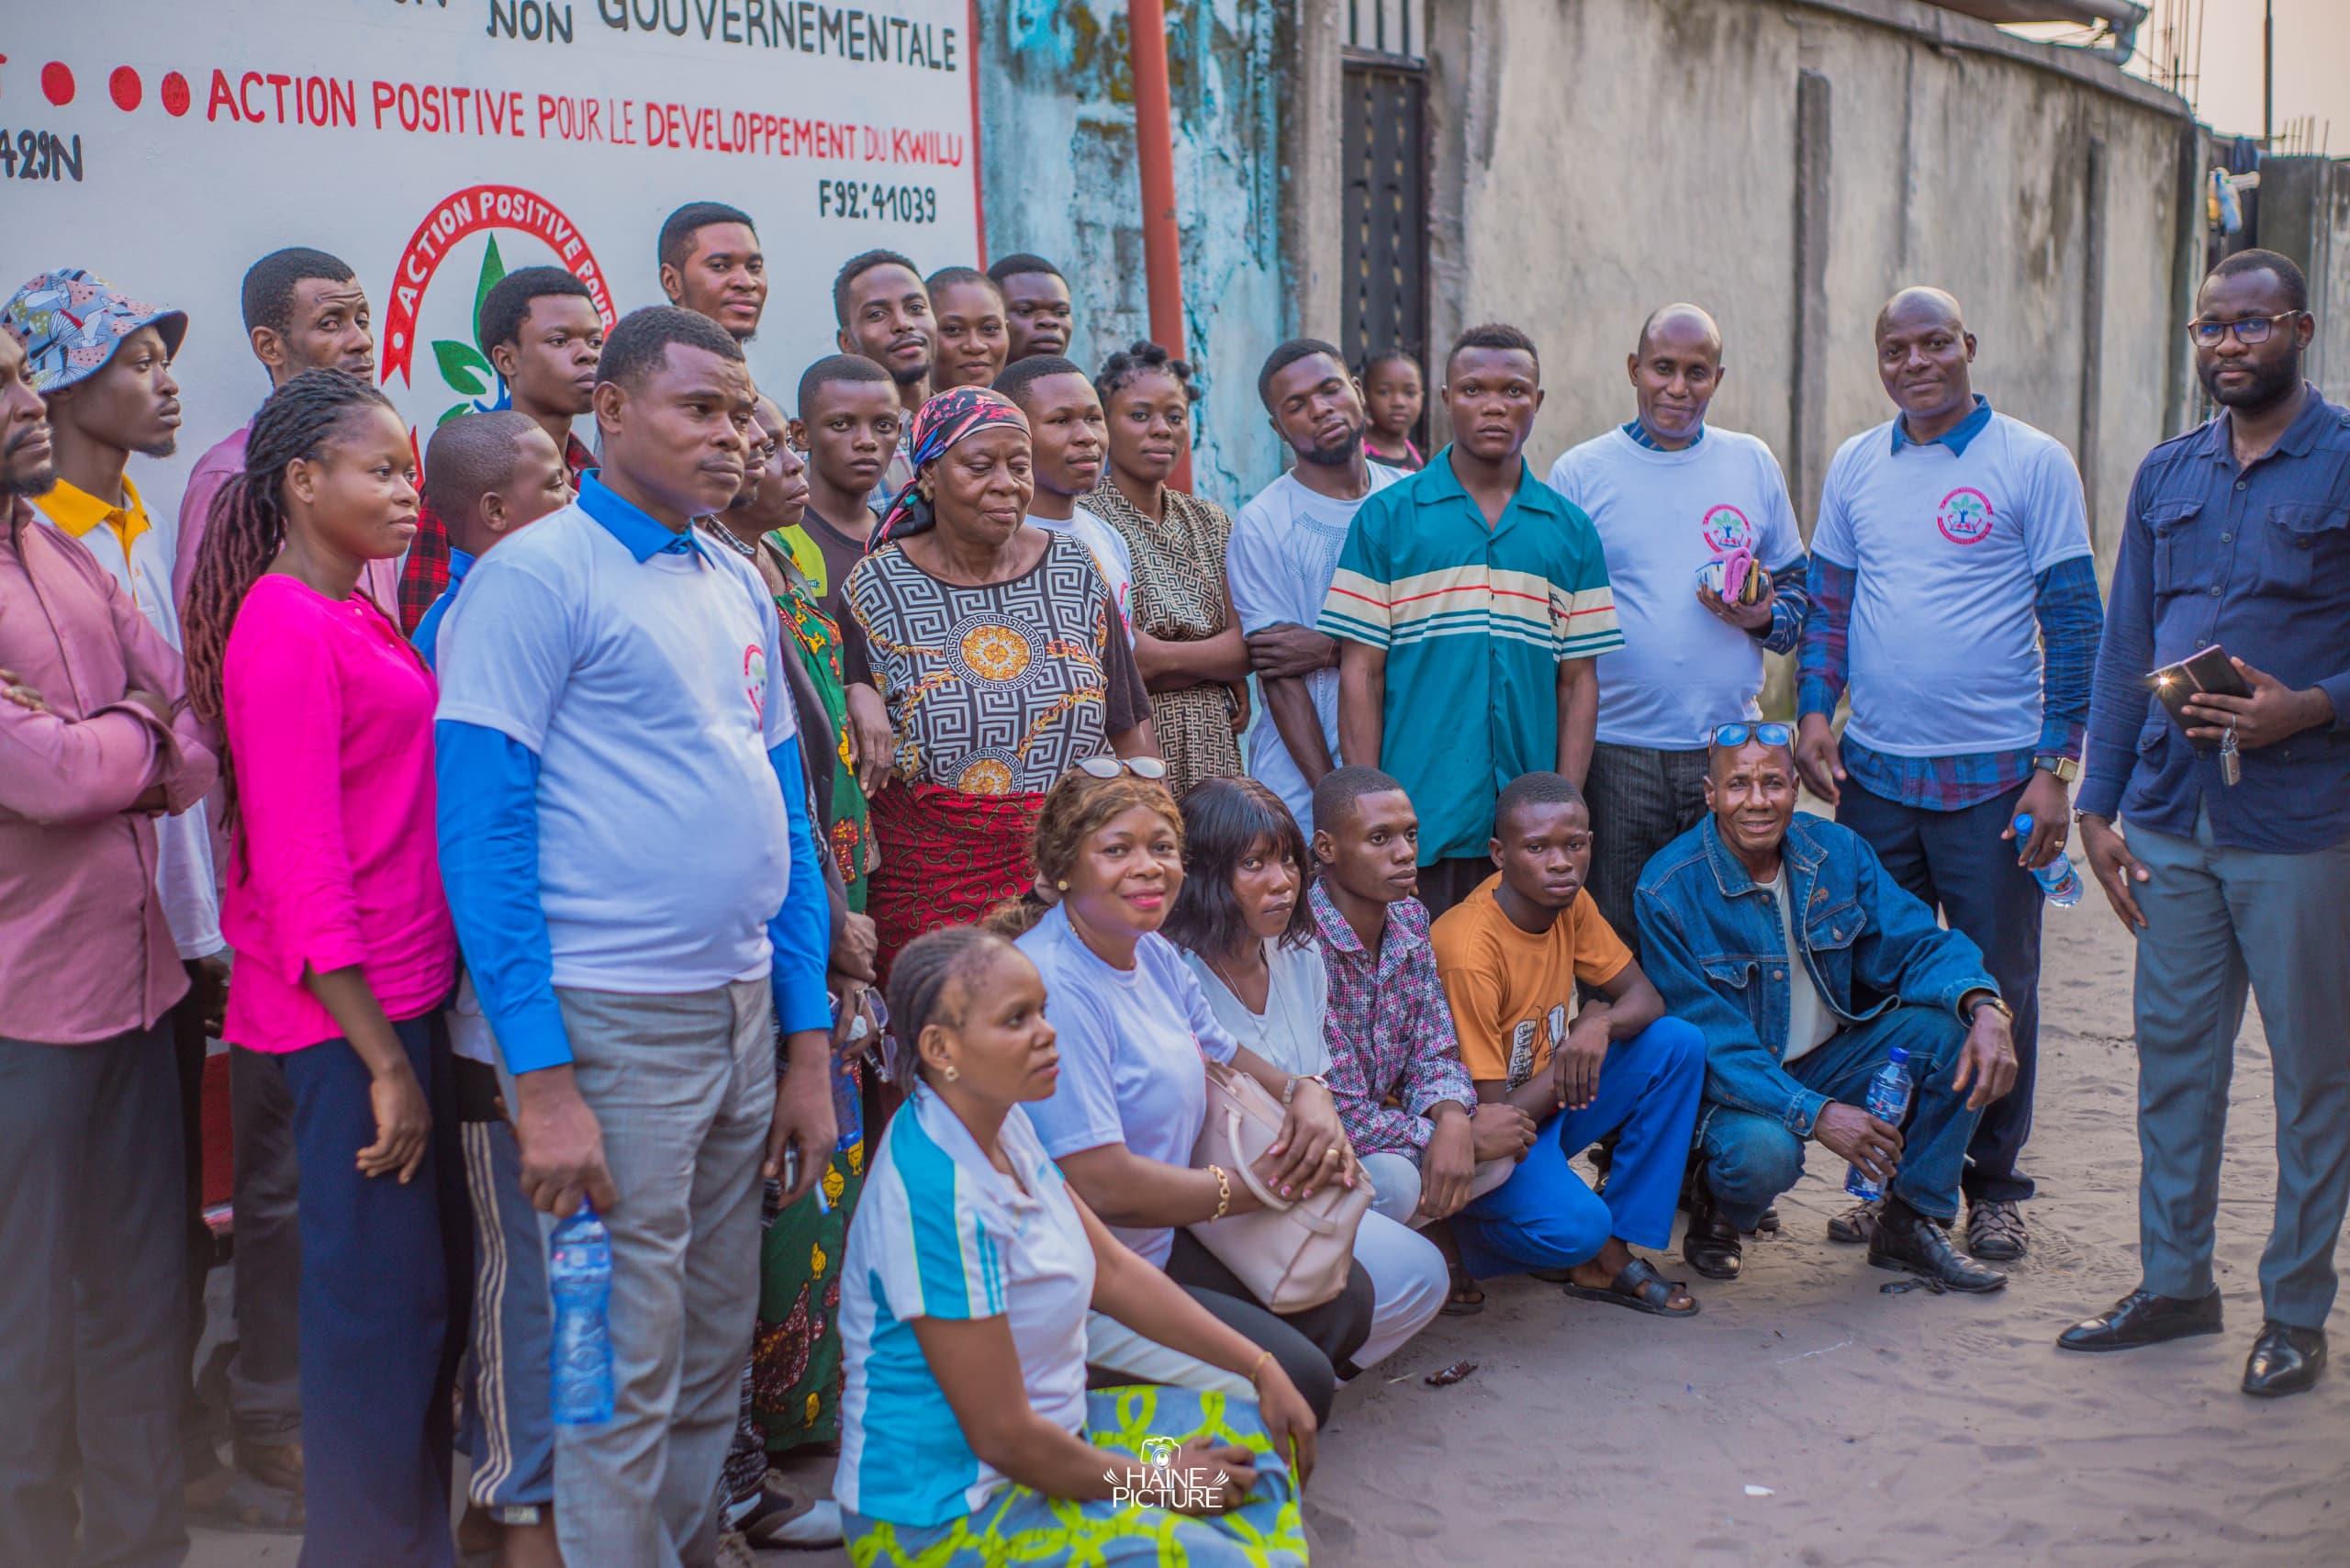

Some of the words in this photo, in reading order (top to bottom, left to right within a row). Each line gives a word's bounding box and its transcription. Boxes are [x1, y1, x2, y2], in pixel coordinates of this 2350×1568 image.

[487, 0, 573, 43] NON
[599, 0, 956, 72] GOUVERNEMENTALE
[207, 69, 356, 127] ACTION
[373, 81, 524, 138] POSITIVE
[538, 94, 605, 142] POUR
[610, 98, 637, 145] LE
[646, 102, 856, 161] DEVELOPPEMENT
[863, 124, 887, 162] DU
[891, 127, 963, 167] KWILU
[397, 196, 473, 319] ACTION
[479, 191, 582, 262] POSITIVE
[576, 259, 614, 331] POUR
